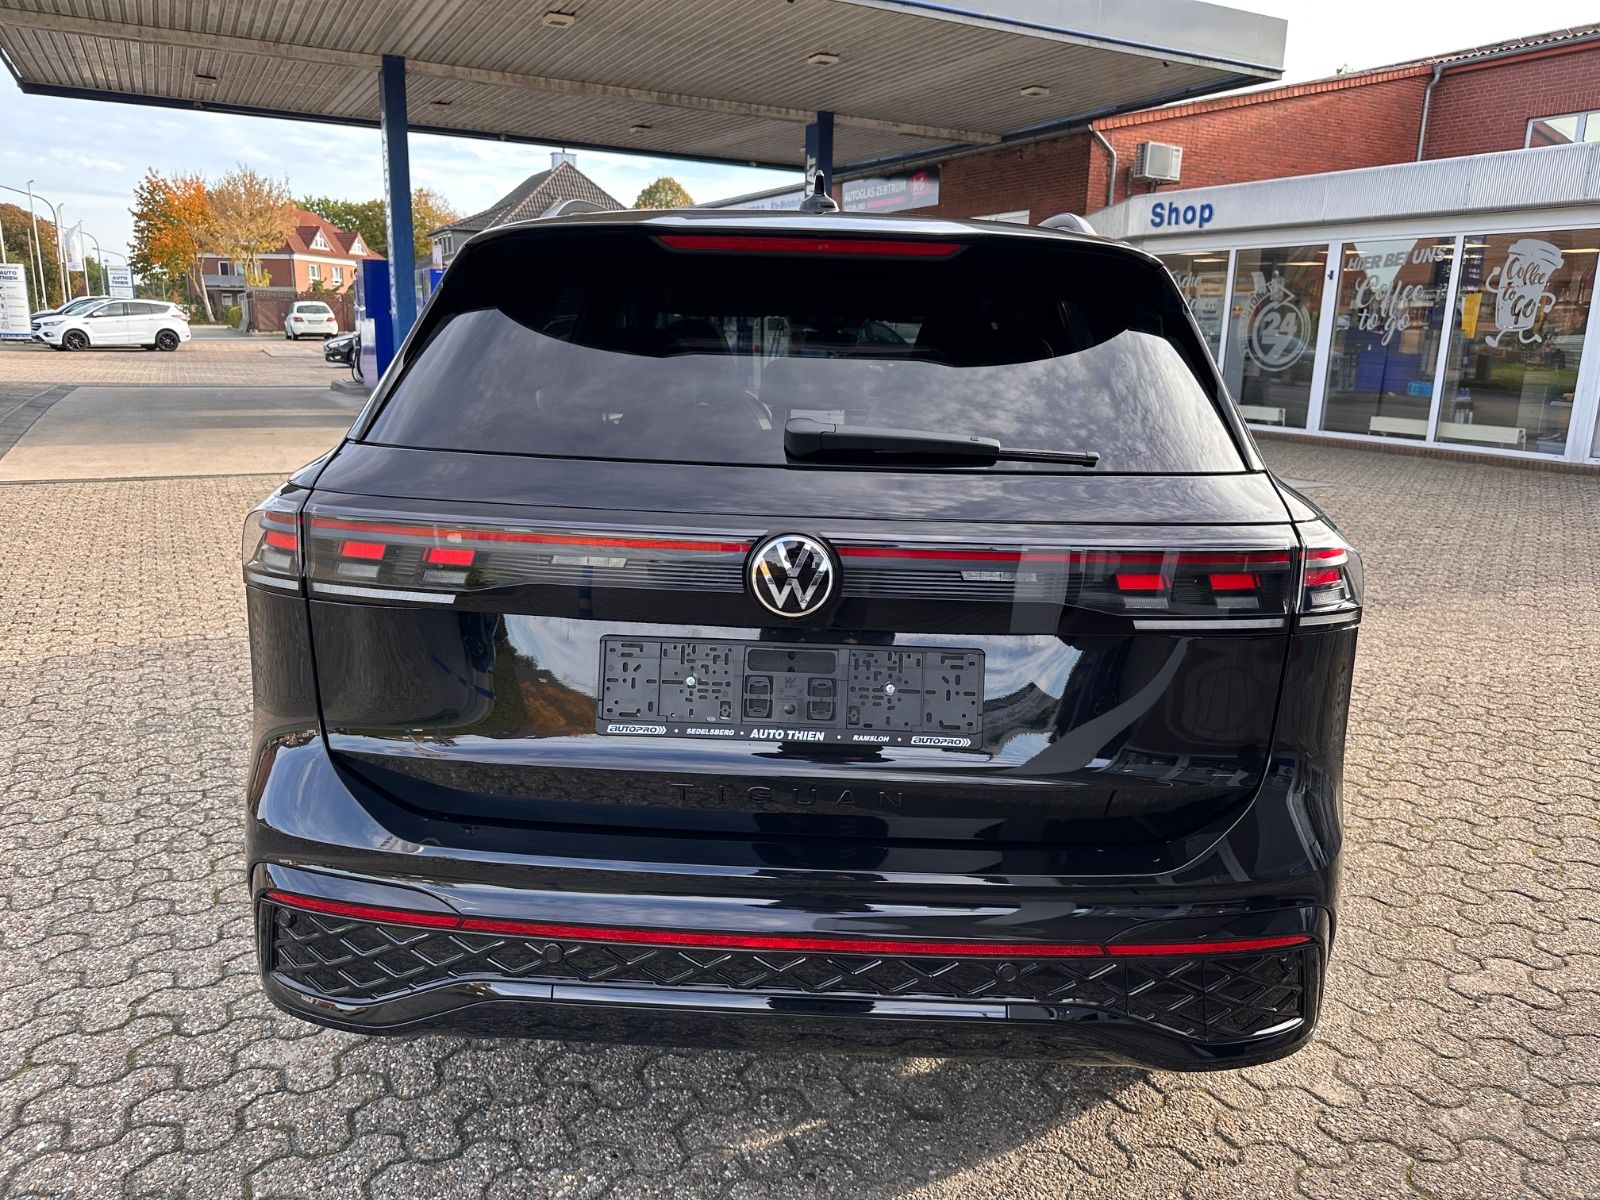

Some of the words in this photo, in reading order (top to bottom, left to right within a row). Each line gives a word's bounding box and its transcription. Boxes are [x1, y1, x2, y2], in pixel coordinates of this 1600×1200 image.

[844, 186, 875, 202] AUTOGLAS
[876, 180, 907, 197] ZENTRUM
[1150, 201, 1213, 228] Shop
[1347, 254, 1380, 271] HIER
[1382, 251, 1410, 268] BEI
[1412, 247, 1446, 264] UNS
[1506, 257, 1547, 286] Coffee
[1355, 274, 1424, 317] Coffee
[1501, 281, 1517, 302] to
[1263, 311, 1297, 337] 24
[1358, 308, 1380, 331] to
[1381, 313, 1410, 346] go
[686, 727, 735, 736] SEDELSBERG
[750, 728, 784, 739] AUTO
[787, 730, 825, 741] THIEN
[853, 734, 890, 742] RAMSLOH
[670, 783, 903, 808] TIGUAN
